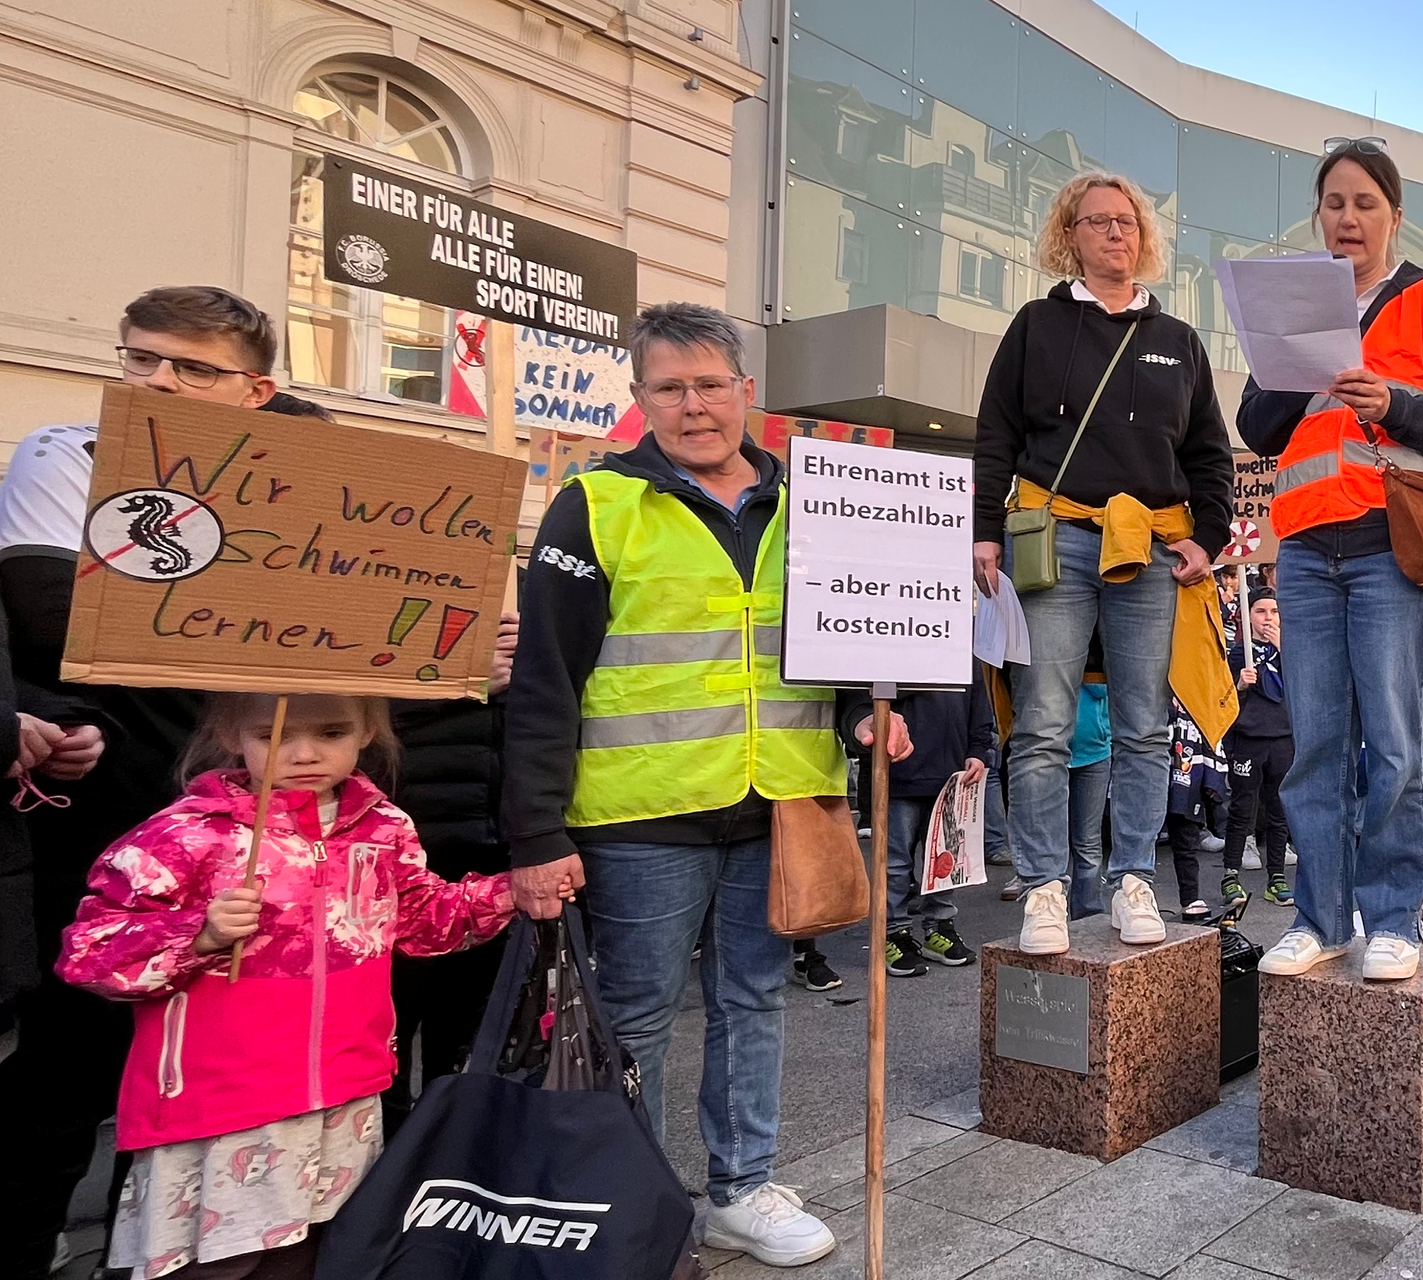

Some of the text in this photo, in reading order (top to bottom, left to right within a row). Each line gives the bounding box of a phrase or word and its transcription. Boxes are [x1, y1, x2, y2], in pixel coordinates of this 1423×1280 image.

[352, 172, 515, 249] EINER FÜR ALLE
[431, 234, 583, 300] ALLE FÜR EINEN!
[476, 279, 619, 340] SPORT VEREINT!
[147, 416, 496, 546] Wir wollen
[803, 454, 967, 493] Ehrenamt ist
[803, 496, 966, 529] unbezahlbar
[829, 573, 891, 597] aber
[898, 579, 962, 602] nicht
[816, 610, 951, 639] kostenlos!
[402, 1196, 599, 1251] WINNER
